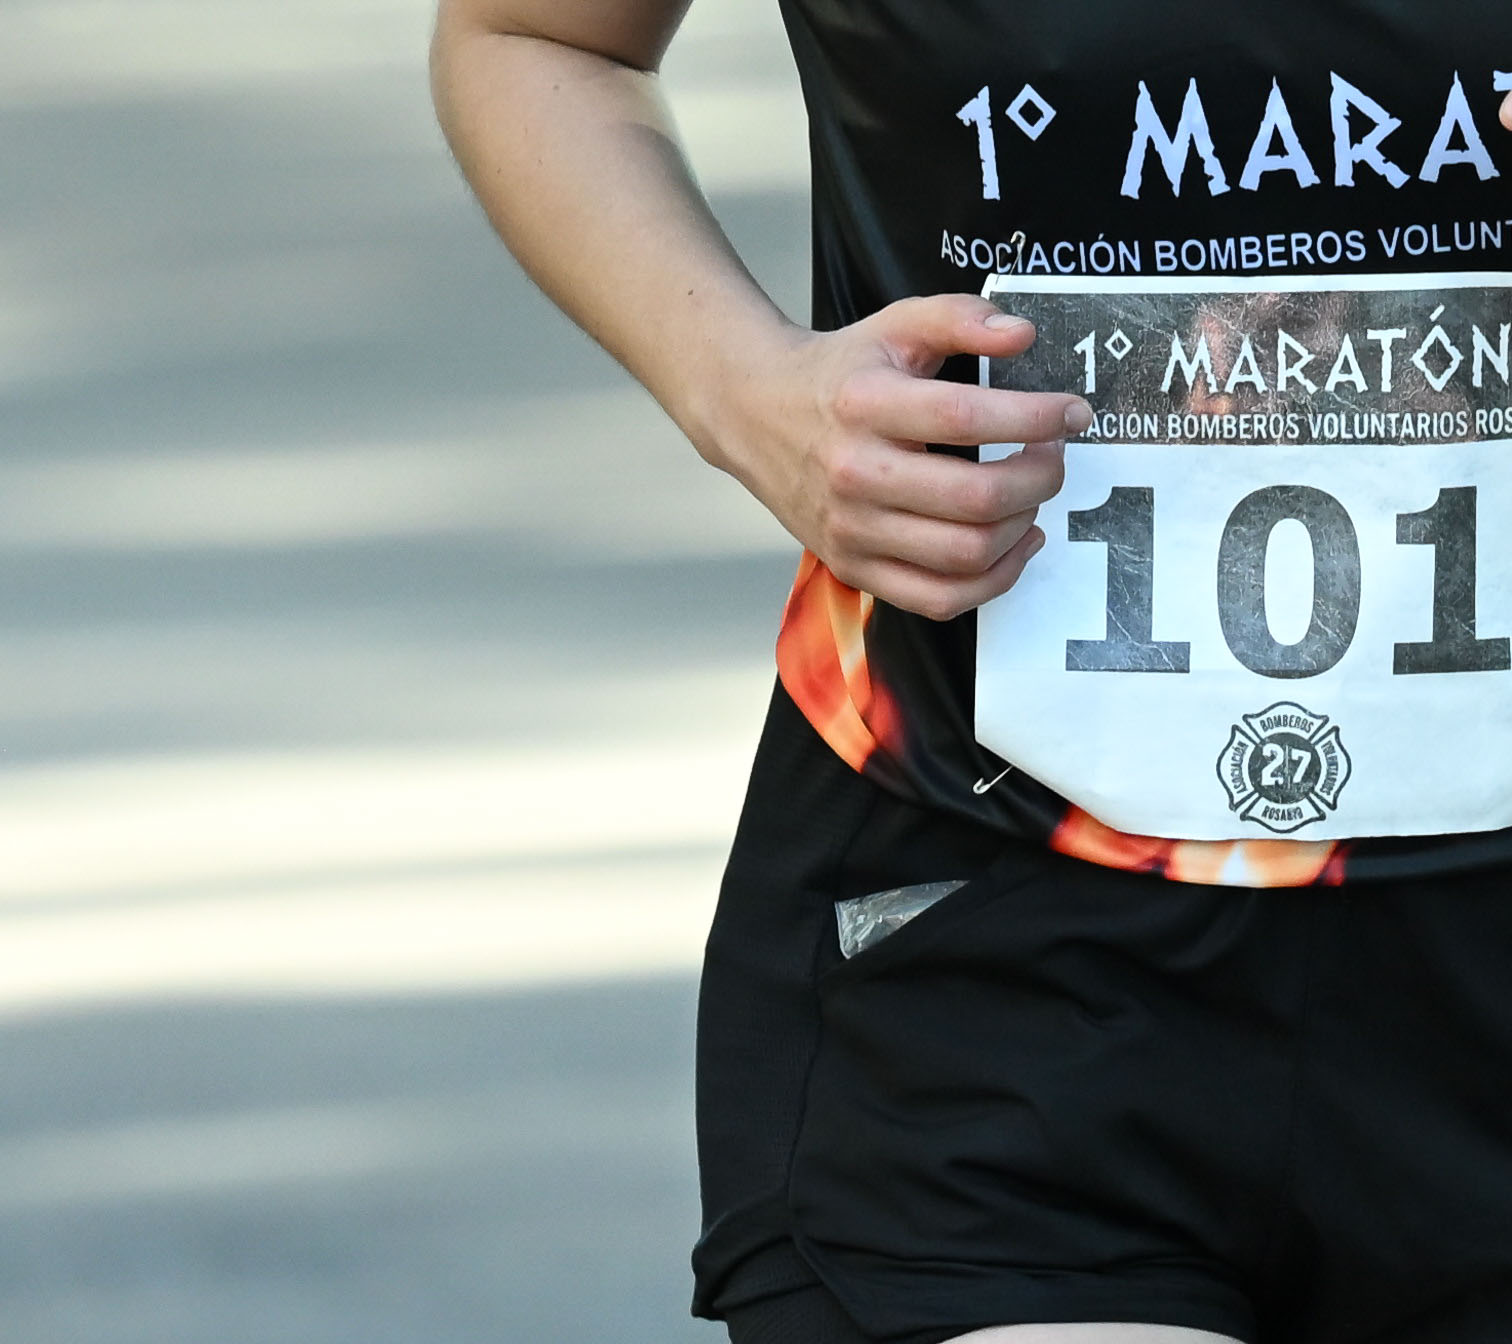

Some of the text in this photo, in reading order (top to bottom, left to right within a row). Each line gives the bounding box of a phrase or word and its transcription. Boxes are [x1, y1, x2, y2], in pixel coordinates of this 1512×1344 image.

[940, 228, 1141, 274] ASOCIACIÓN
[1154, 229, 1367, 274] BOMBEROS
[1160, 303, 1511, 395] MARATÓN
[1080, 406, 1159, 440] ACIÓN
[1167, 412, 1300, 440] BOMBEROS
[1309, 410, 1469, 440] VOLUNTARIOS
[1065, 484, 1512, 680] 101
[1259, 713, 1315, 734] BOMBEROS
[1260, 742, 1312, 786] 27
